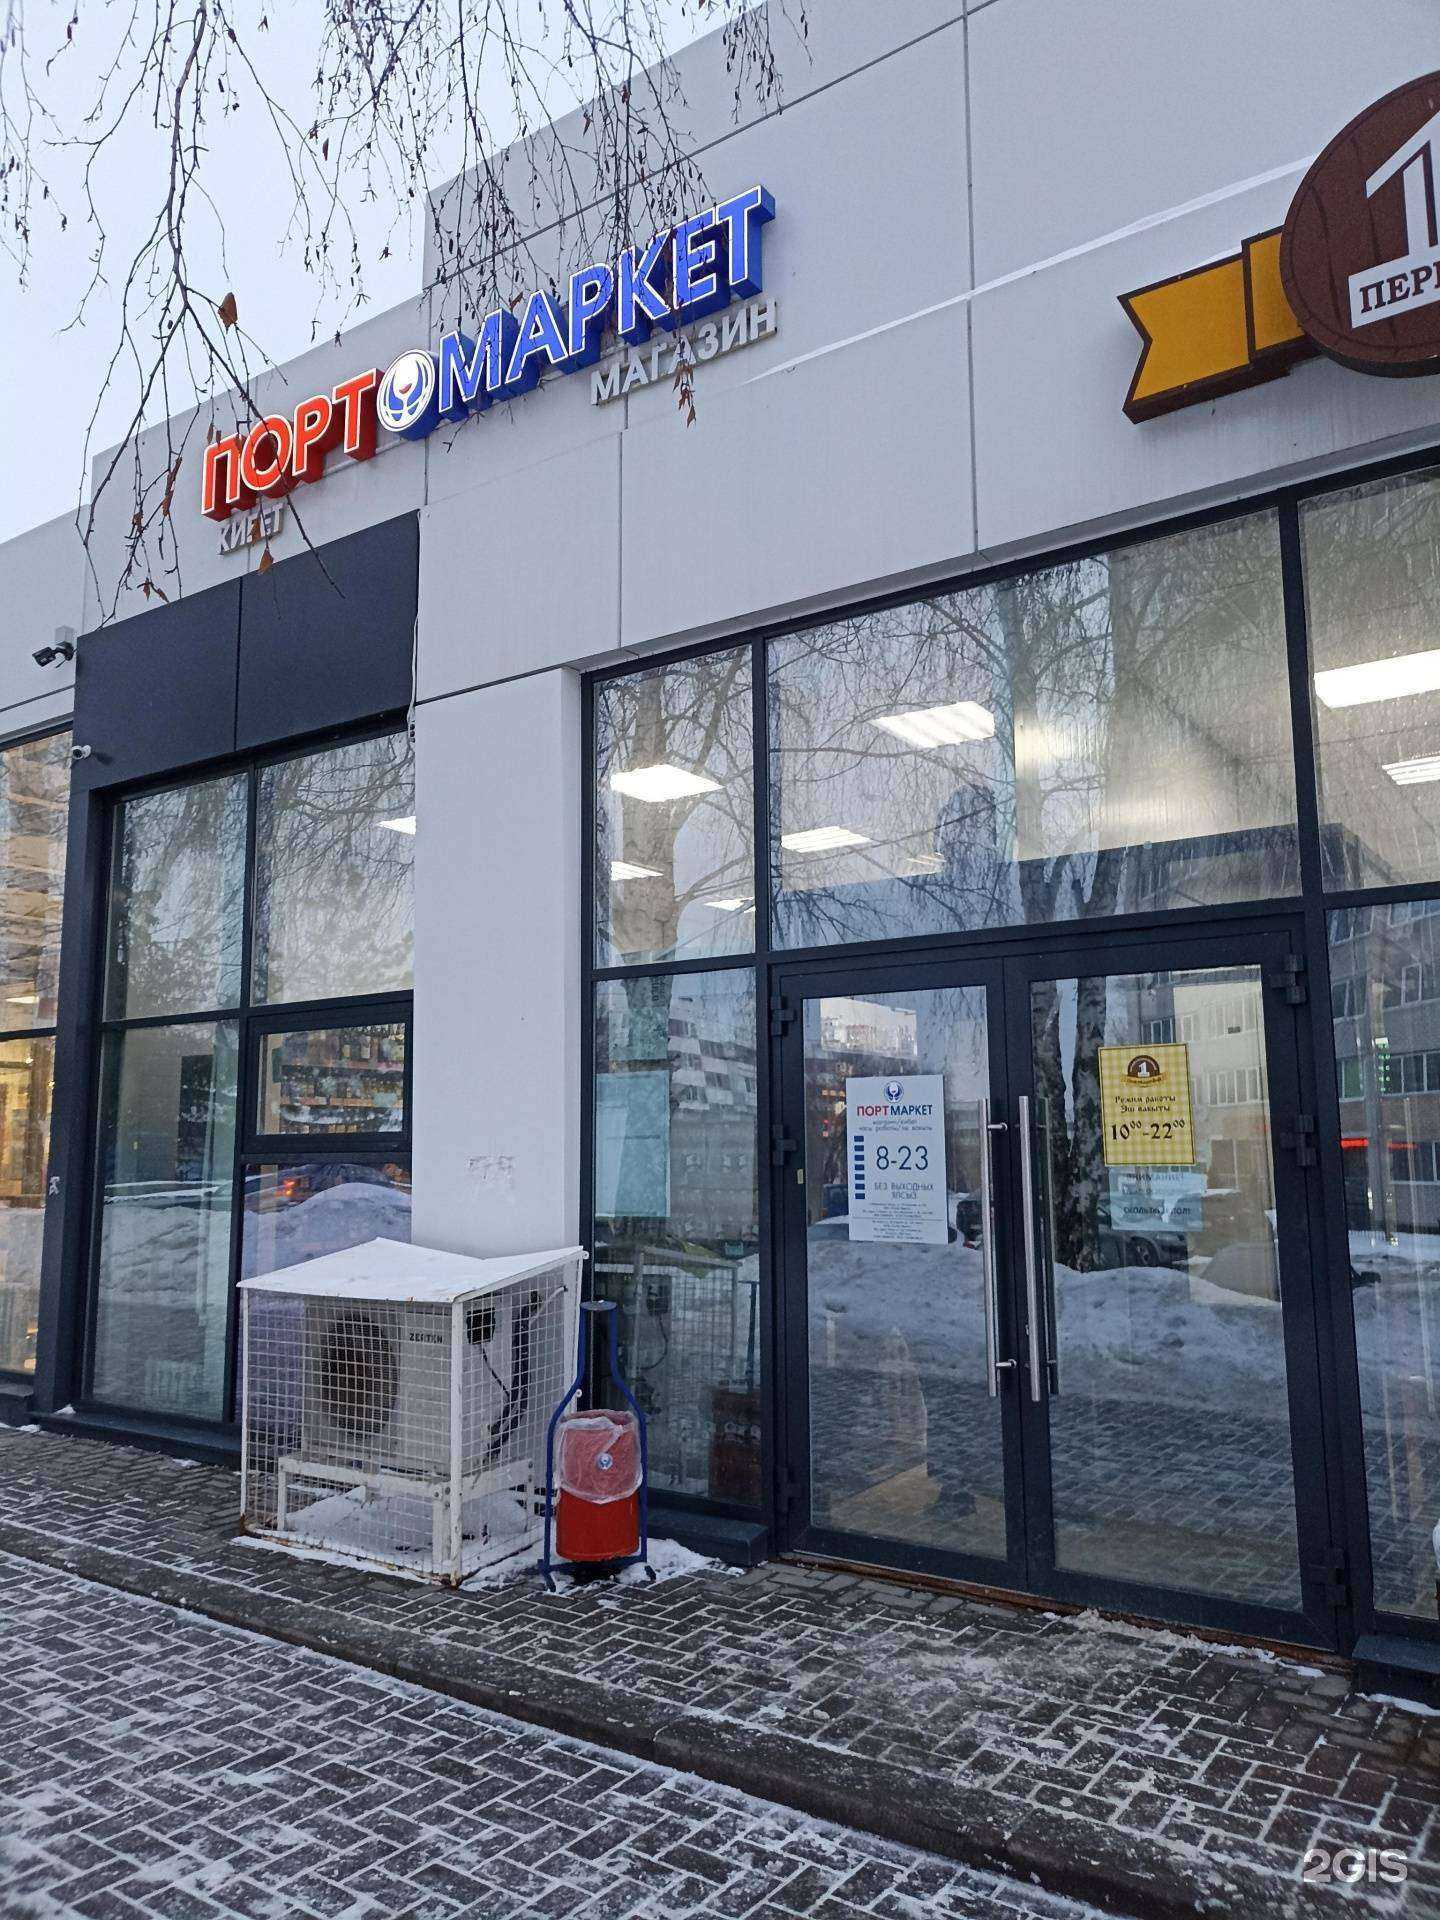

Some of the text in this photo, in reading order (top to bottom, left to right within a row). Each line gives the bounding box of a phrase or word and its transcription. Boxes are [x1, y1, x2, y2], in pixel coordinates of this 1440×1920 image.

[438, 185, 774, 422] МАРКЕТ
[590, 302, 777, 405] МАГАЗИН
[1138, 1061, 1150, 1078] 1
[876, 1145, 929, 1171] 8-23
